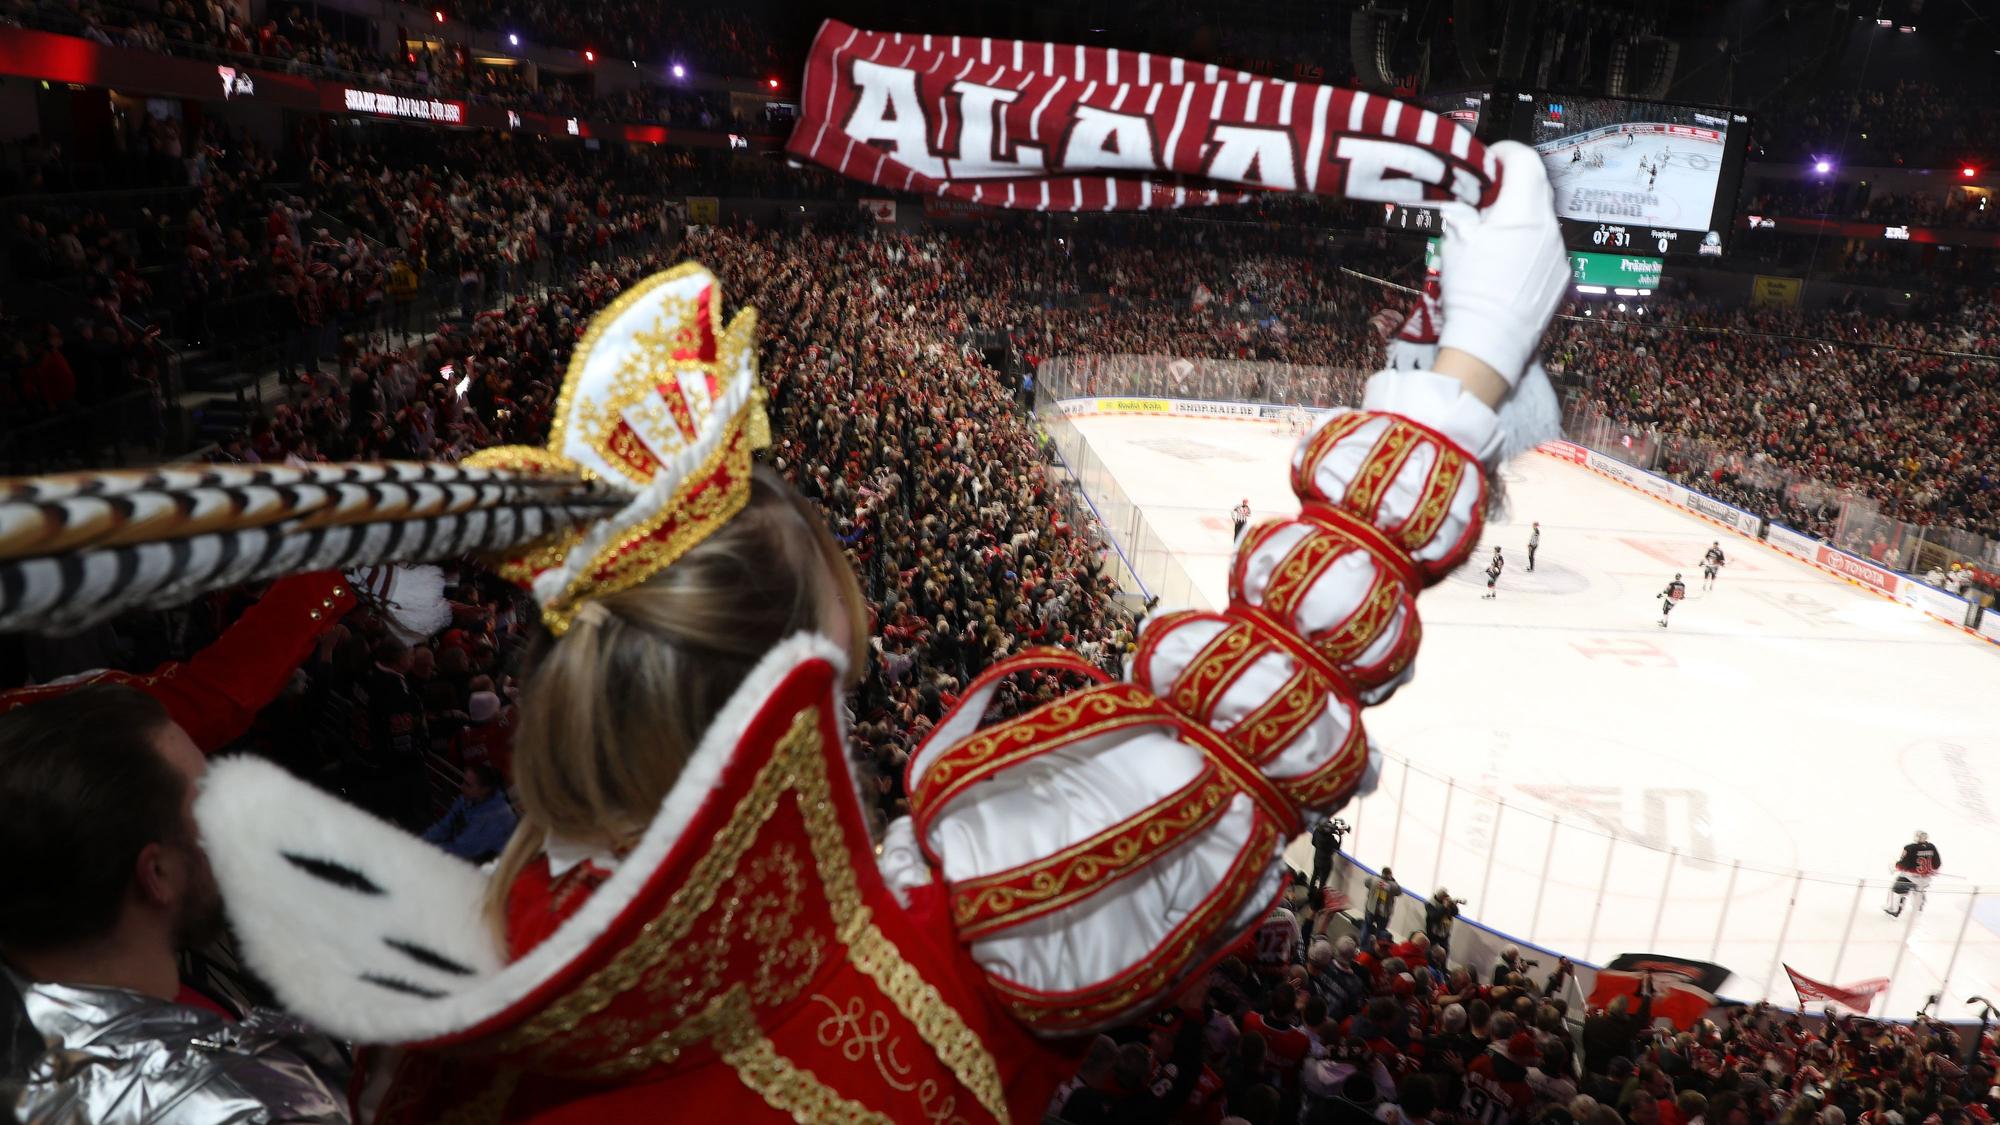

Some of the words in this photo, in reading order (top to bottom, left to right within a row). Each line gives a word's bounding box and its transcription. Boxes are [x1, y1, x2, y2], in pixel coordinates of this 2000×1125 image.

[1593, 230, 1630, 247] 07:31
[1658, 239, 1668, 253] 0
[1843, 559, 1886, 587] TOYOTA
